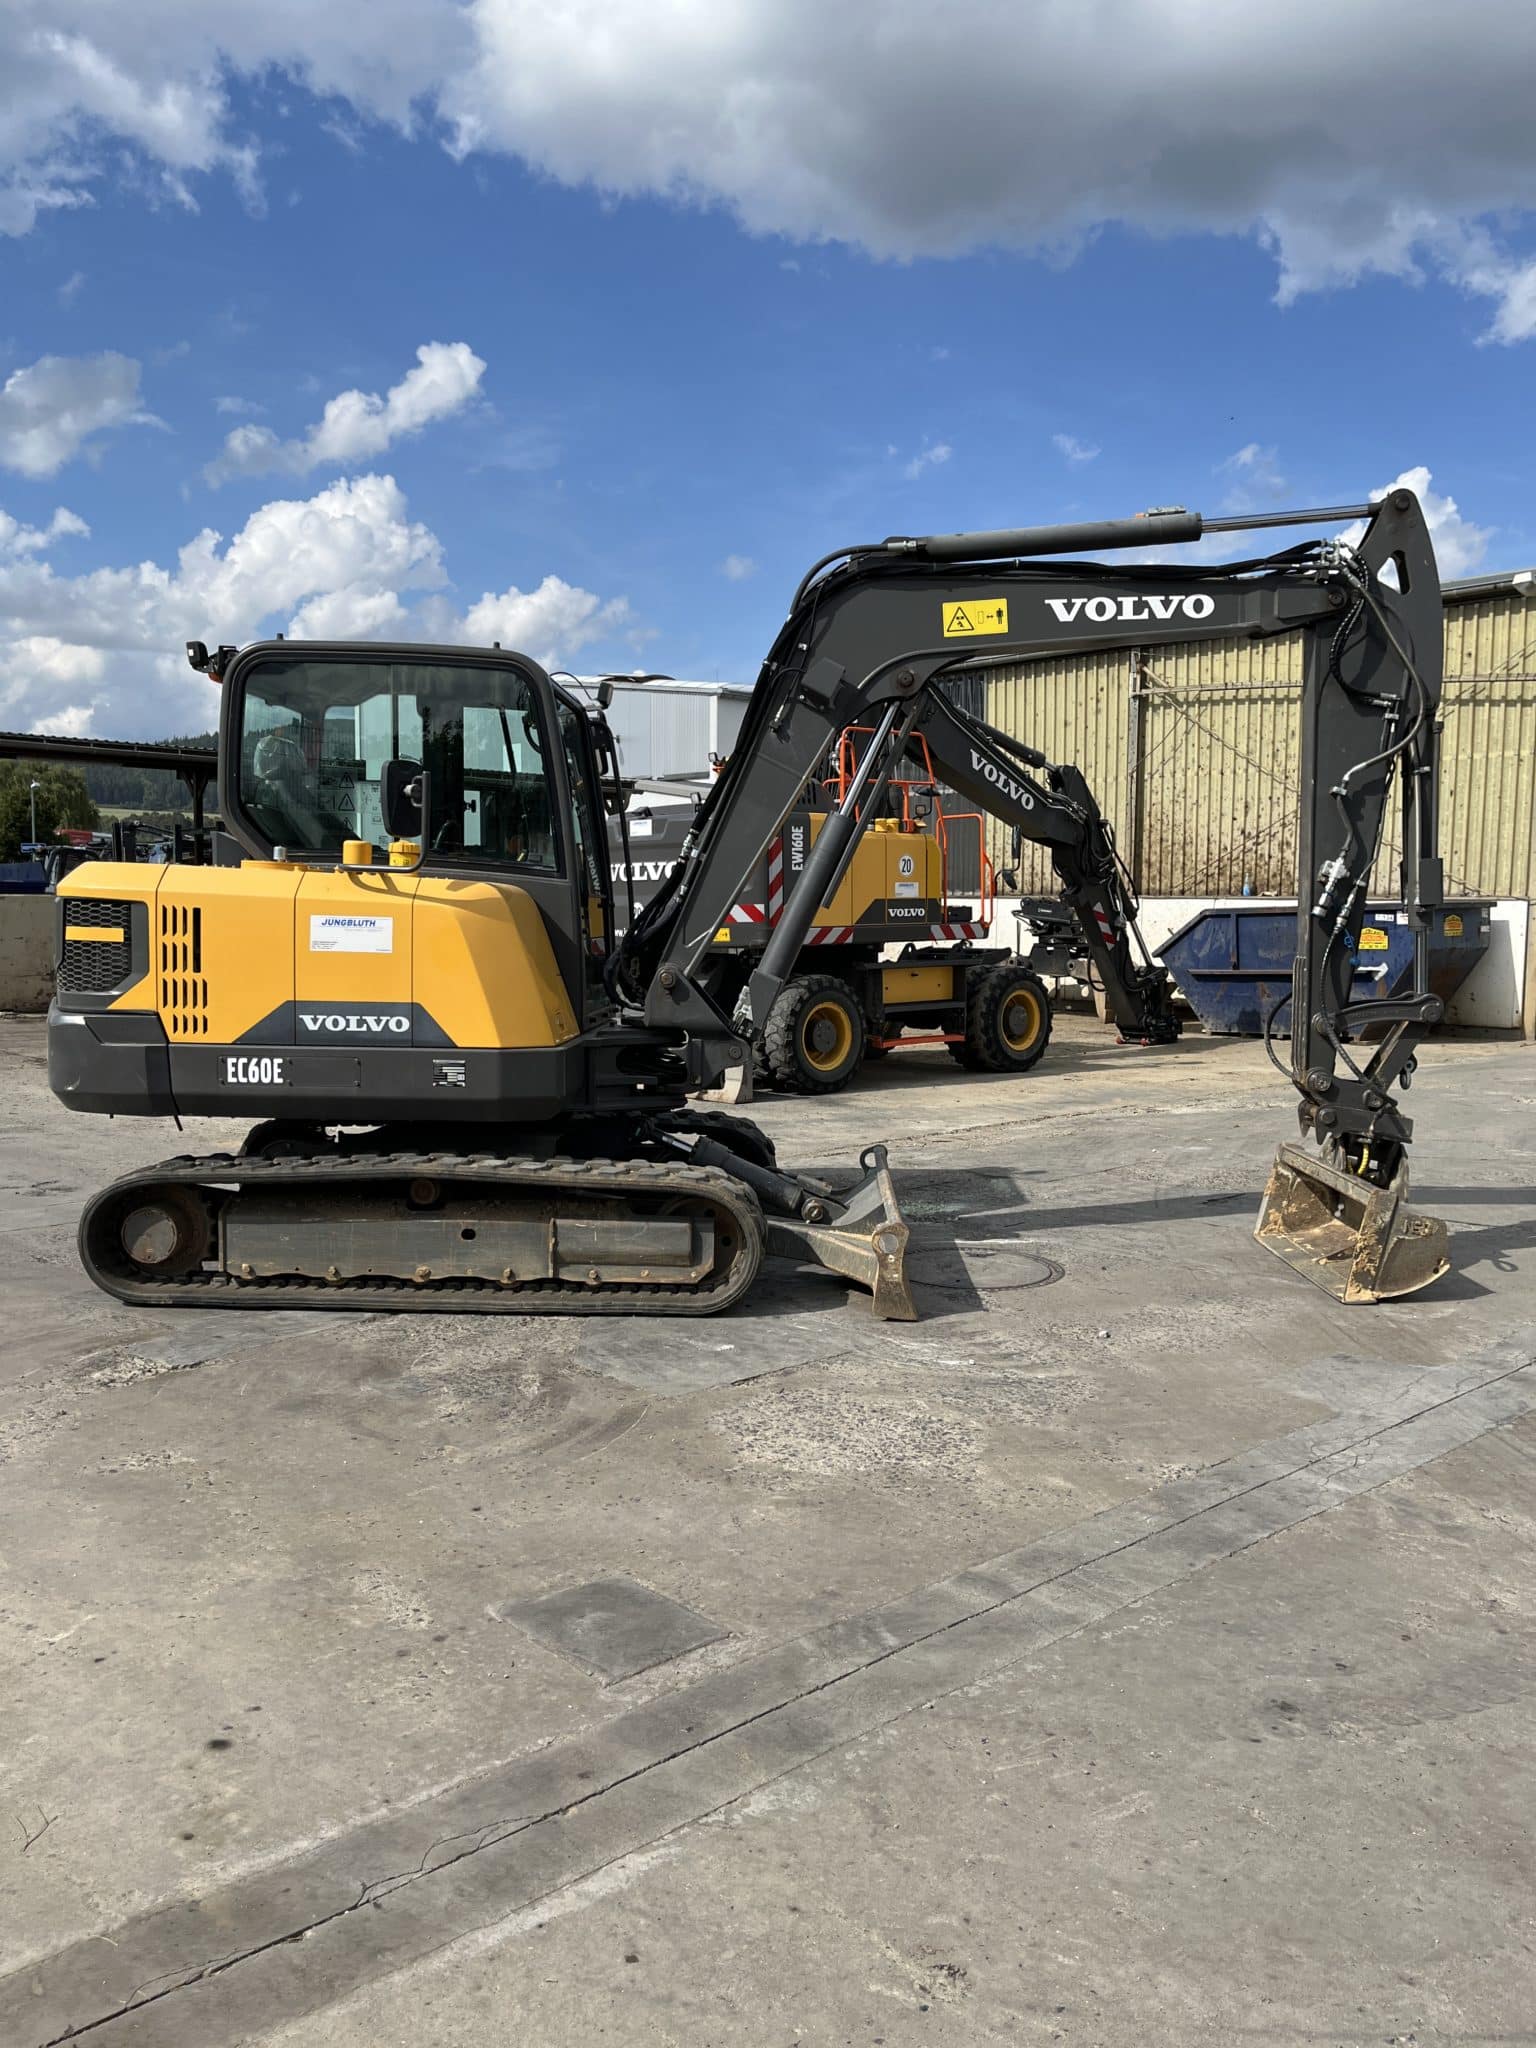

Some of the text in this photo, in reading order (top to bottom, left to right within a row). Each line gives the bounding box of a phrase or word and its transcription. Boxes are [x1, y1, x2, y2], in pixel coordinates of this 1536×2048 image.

[1044, 594, 1215, 622] VOLVO
[969, 748, 1035, 810] VOLVO
[791, 826, 804, 871] EW160E
[901, 858, 912, 873] 20
[321, 918, 377, 927] JUNGBLUTH
[888, 908, 926, 918] VOLVO
[299, 1014, 410, 1033] VOLVO
[226, 1057, 284, 1084] EC60E
